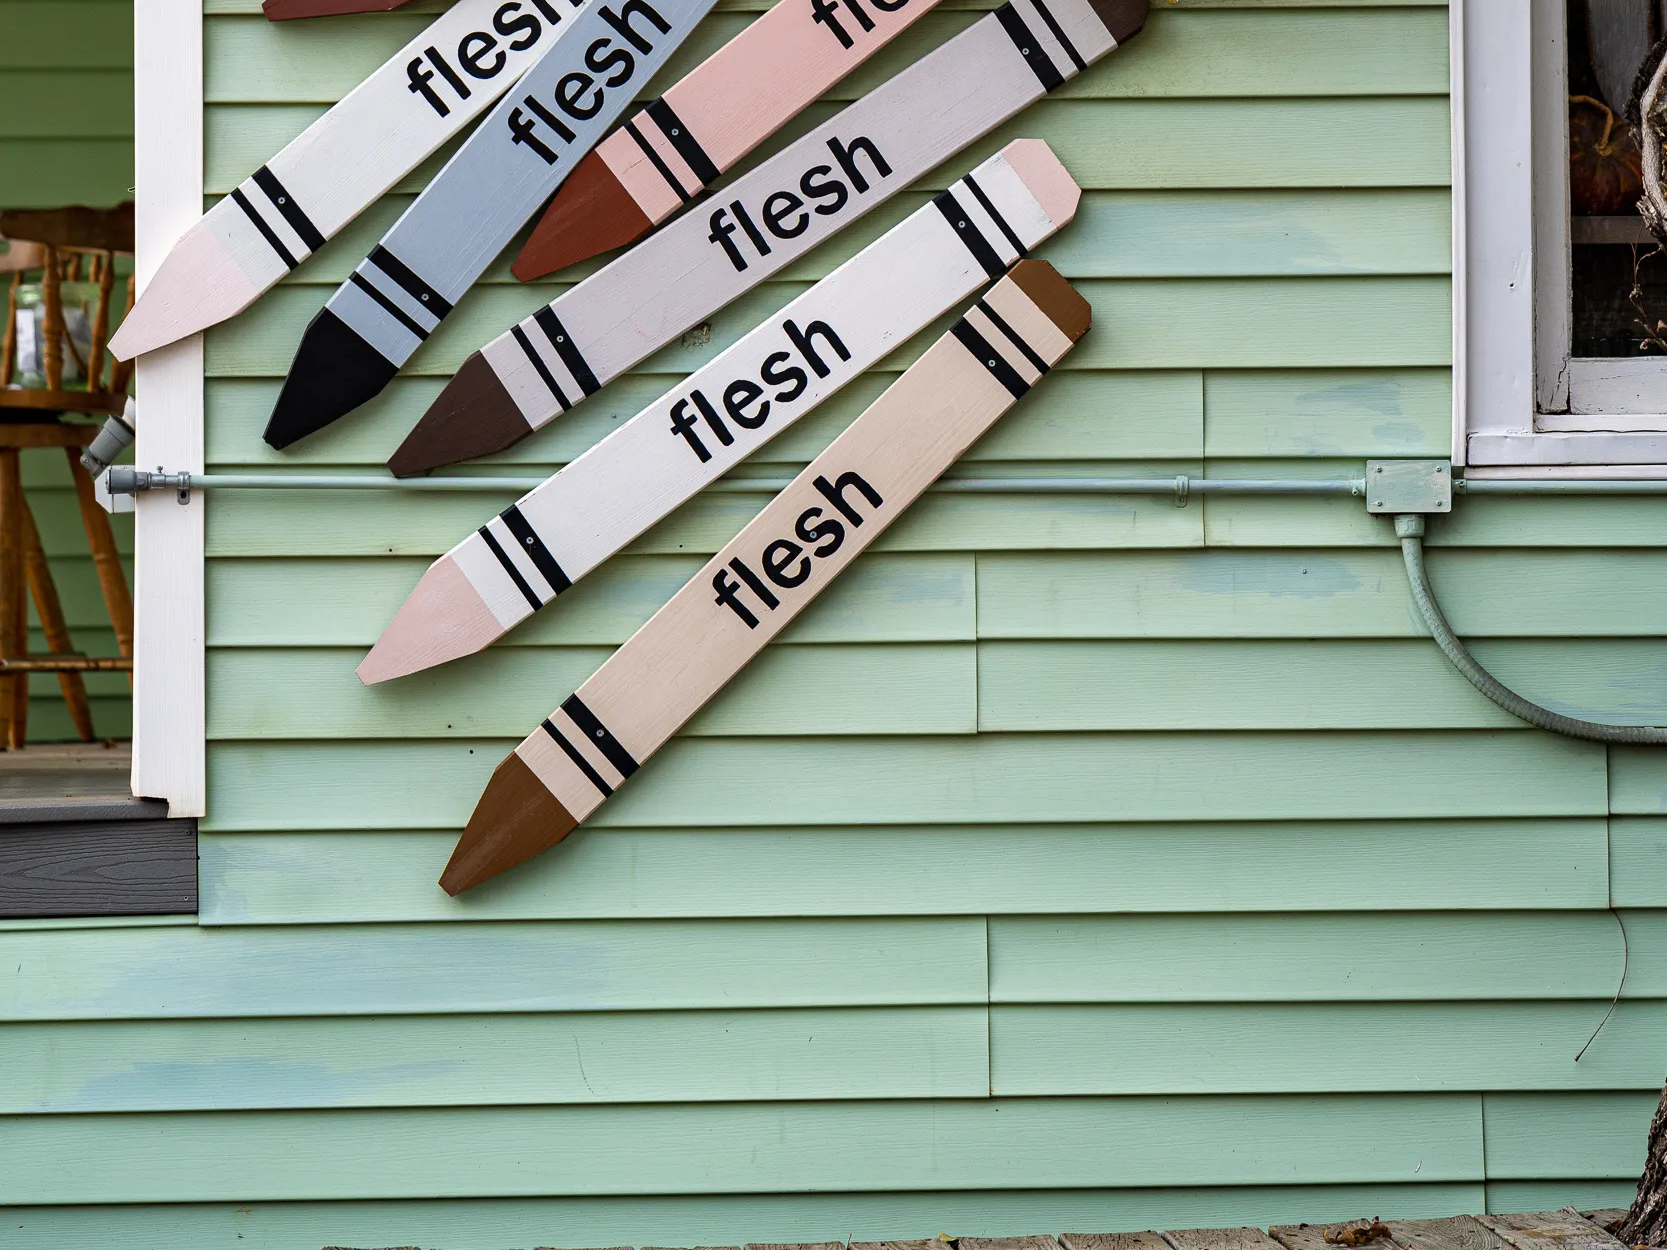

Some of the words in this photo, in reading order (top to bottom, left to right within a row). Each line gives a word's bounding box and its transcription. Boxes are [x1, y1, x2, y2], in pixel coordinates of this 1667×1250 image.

[708, 136, 892, 272] flesh
[670, 319, 851, 463] flesh
[712, 471, 883, 629] flesh
